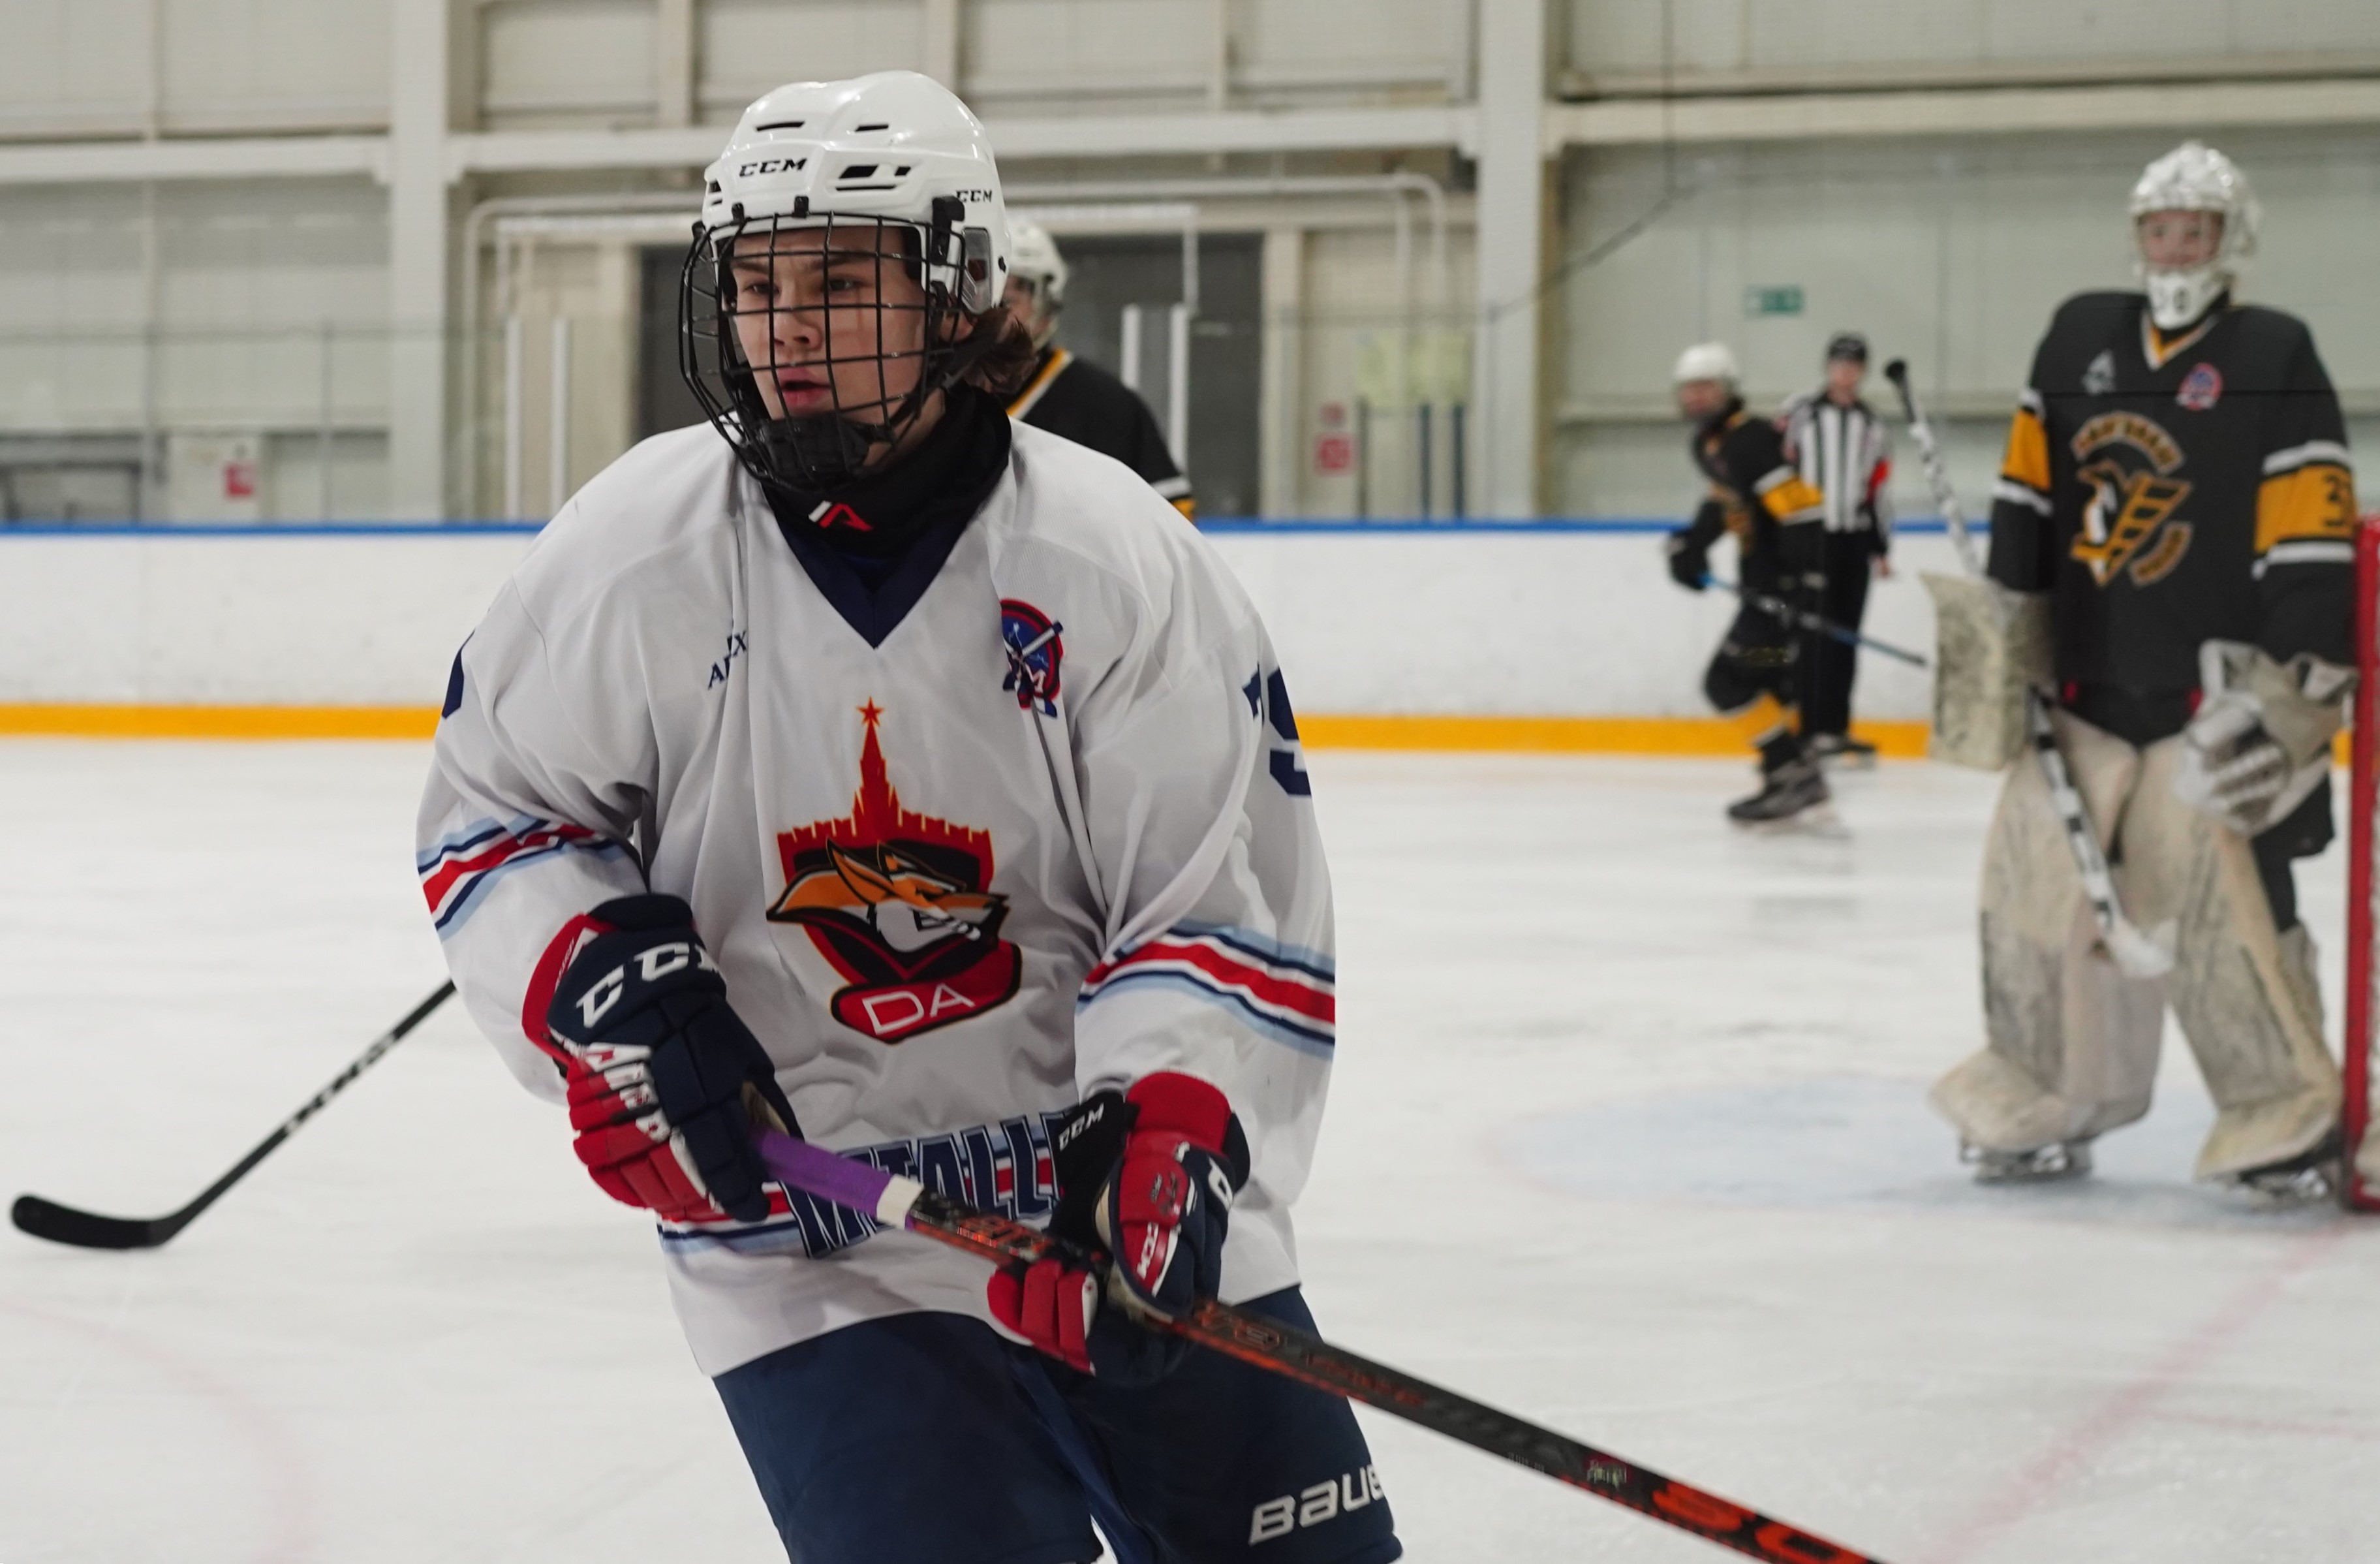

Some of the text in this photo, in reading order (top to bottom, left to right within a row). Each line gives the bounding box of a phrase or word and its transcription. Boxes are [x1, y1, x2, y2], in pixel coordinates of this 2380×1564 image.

[739, 157, 807, 178] CCM
[956, 189, 993, 204] CCM
[862, 984, 975, 1035] DA
[1059, 1103, 1105, 1152] CCM
